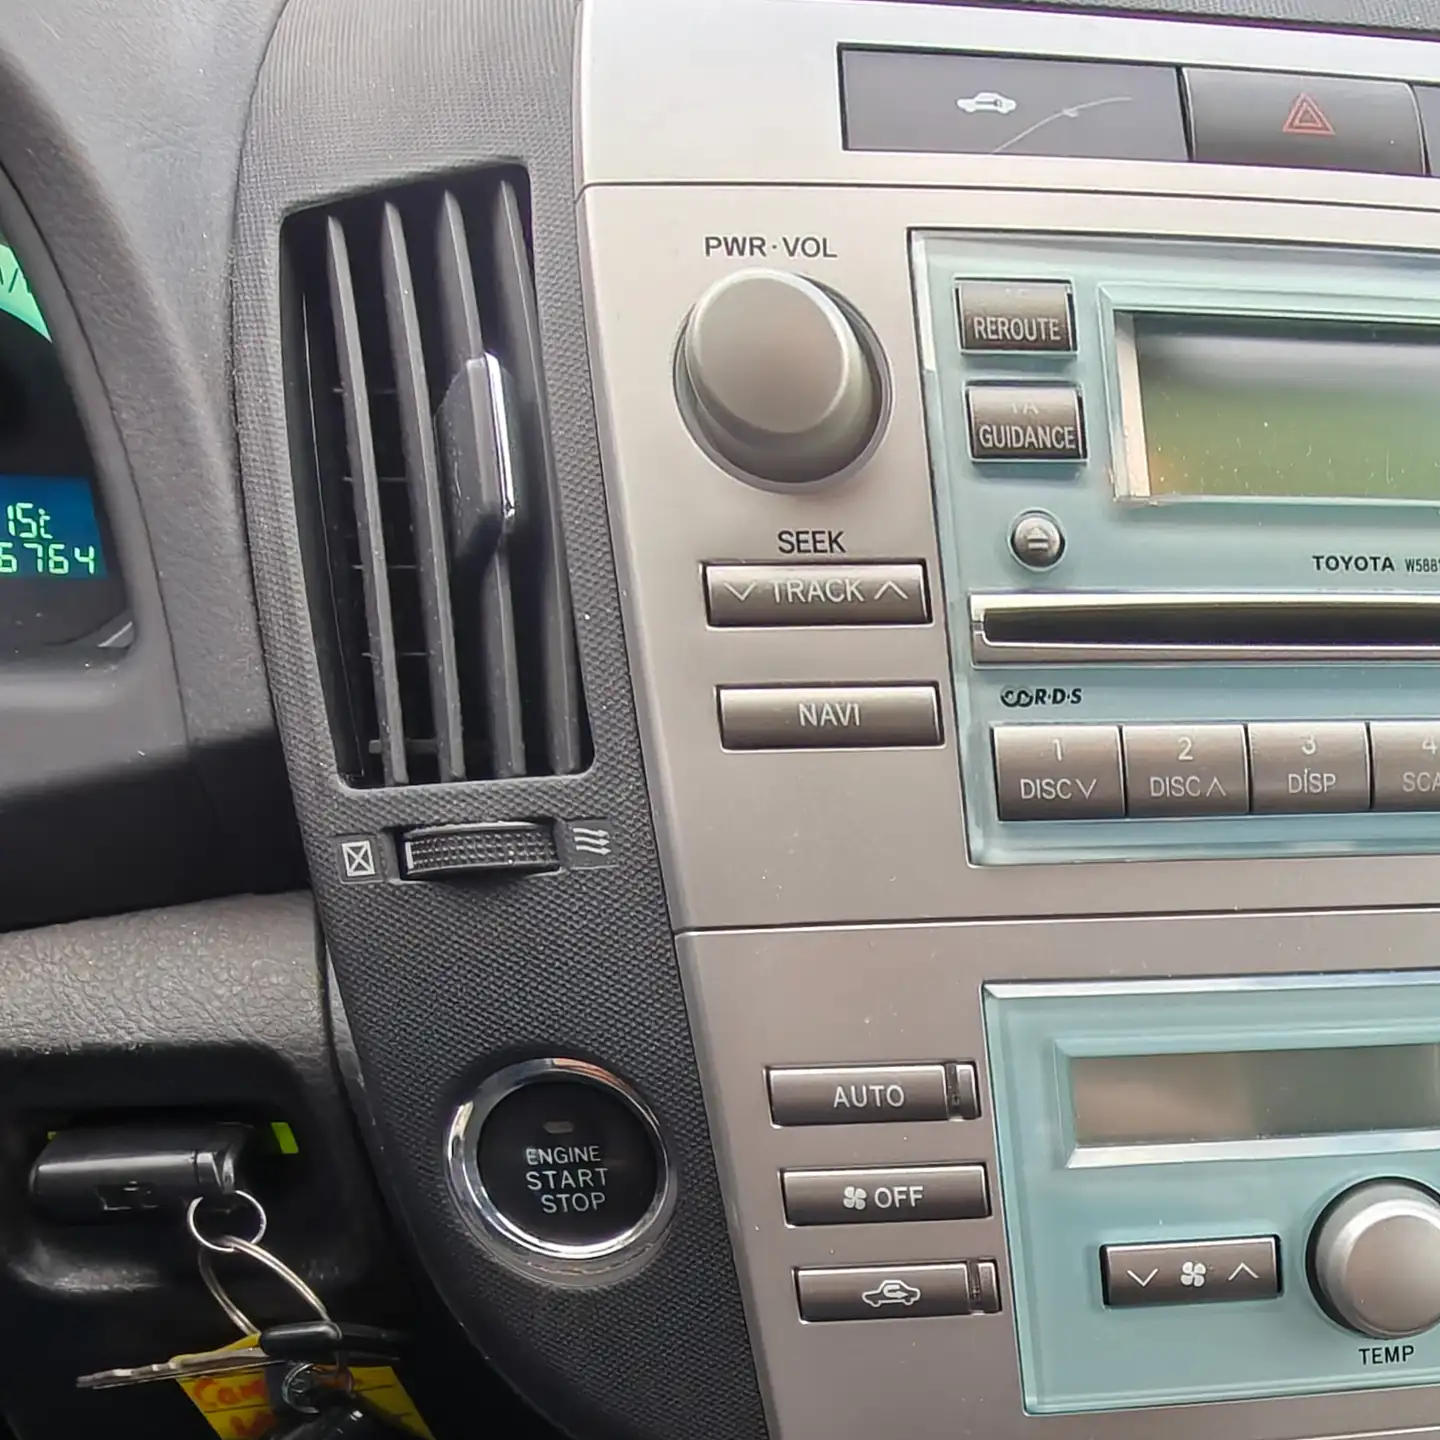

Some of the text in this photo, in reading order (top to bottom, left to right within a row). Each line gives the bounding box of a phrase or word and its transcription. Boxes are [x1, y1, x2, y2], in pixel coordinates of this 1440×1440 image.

[973, 316, 1061, 342] REROUTE
[978, 424, 1077, 450] GUIDANCE
[777, 530, 847, 555] SEEK
[1312, 554, 1396, 573] TOYOTA
[772, 578, 865, 604] TRACK
[798, 702, 862, 728] NAVI
[1051, 738, 1063, 762] 1
[1177, 736, 1195, 762] 2
[1301, 734, 1317, 756] 3
[1421, 735, 1439, 756] 4
[1020, 778, 1073, 801] DISC
[1150, 776, 1201, 799] DISC
[1288, 771, 1338, 795] DISP
[833, 1084, 905, 1109] AUTO
[525, 1145, 602, 1166] ENGINE
[525, 1167, 609, 1191] START
[541, 1192, 606, 1214] STOP
[874, 1184, 924, 1209] OFF
[1357, 1343, 1416, 1367] TEMP
